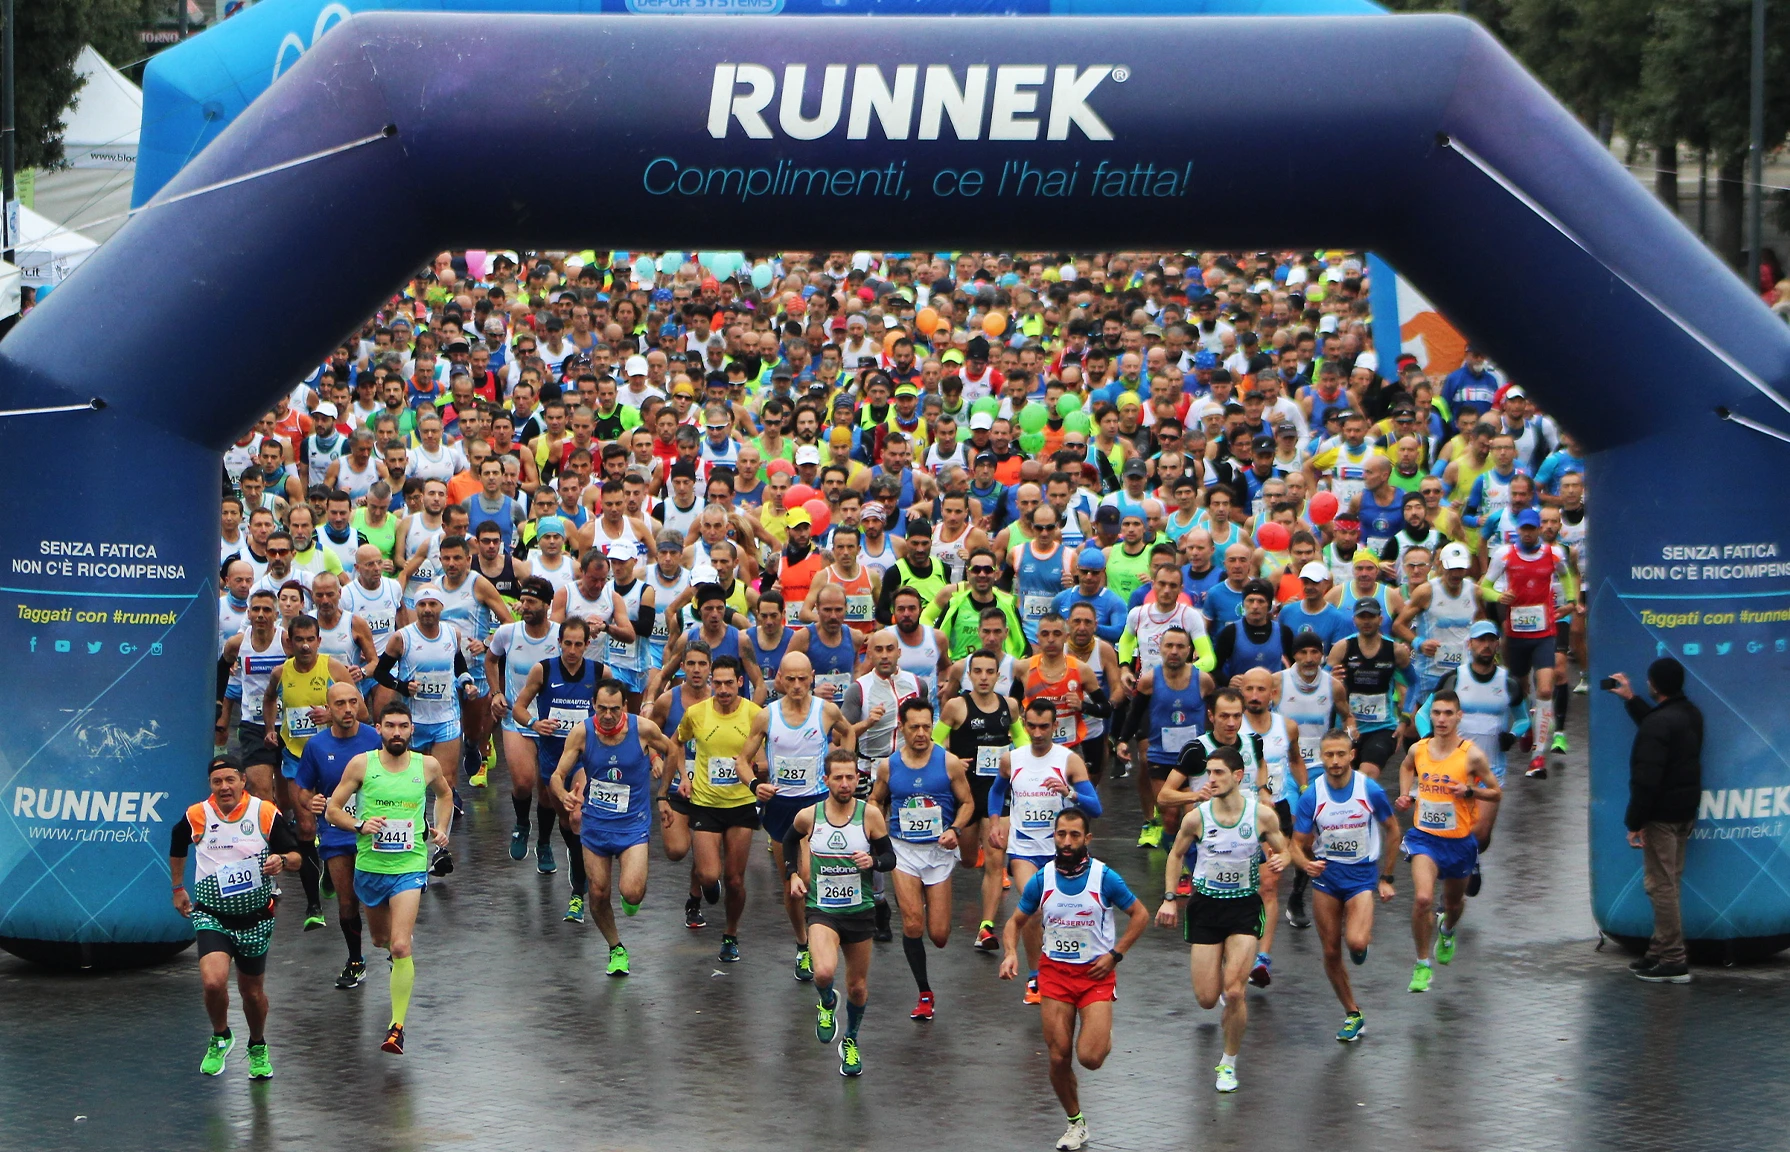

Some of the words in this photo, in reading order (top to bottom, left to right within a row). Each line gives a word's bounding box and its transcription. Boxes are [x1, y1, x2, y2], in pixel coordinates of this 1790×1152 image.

[642, 157, 911, 202] Complimenti,
[932, 168, 984, 197] ce
[999, 160, 1077, 197] l'hai
[1091, 160, 1194, 197] fatta!
[40, 541, 95, 557] SENZA
[100, 543, 157, 559] FATICA
[1662, 546, 1719, 561] SENZA
[1723, 544, 1777, 559] FATICA
[12, 559, 42, 574] NON
[46, 559, 73, 576] C'È
[77, 563, 186, 579] RICOMPENSA
[1631, 566, 1665, 580] NON
[1669, 564, 1698, 580] C'È
[17, 604, 72, 624] Taggati
[76, 611, 107, 623] con
[113, 609, 177, 625] #runnek
[1640, 610, 1700, 628] Taggati
[1703, 612, 1735, 624] con
[368, 618, 391, 630] 3154
[1443, 652, 1462, 662] 248
[420, 683, 447, 694] 1517
[551, 698, 591, 706] AERONAUTICA
[1358, 704, 1377, 715] 167
[783, 769, 807, 780] 287
[597, 790, 619, 803] 324
[1025, 810, 1055, 821] 5162
[1422, 811, 1447, 823] 4563
[909, 819, 932, 831] 297
[29, 826, 150, 843] www.runnek.it
[377, 831, 408, 843] 2441
[1330, 840, 1358, 852] 4629
[820, 864, 858, 874] pedone
[227, 869, 252, 885] 430
[1216, 871, 1240, 883] 439
[825, 886, 854, 898] 2646
[1055, 939, 1079, 952] 959
